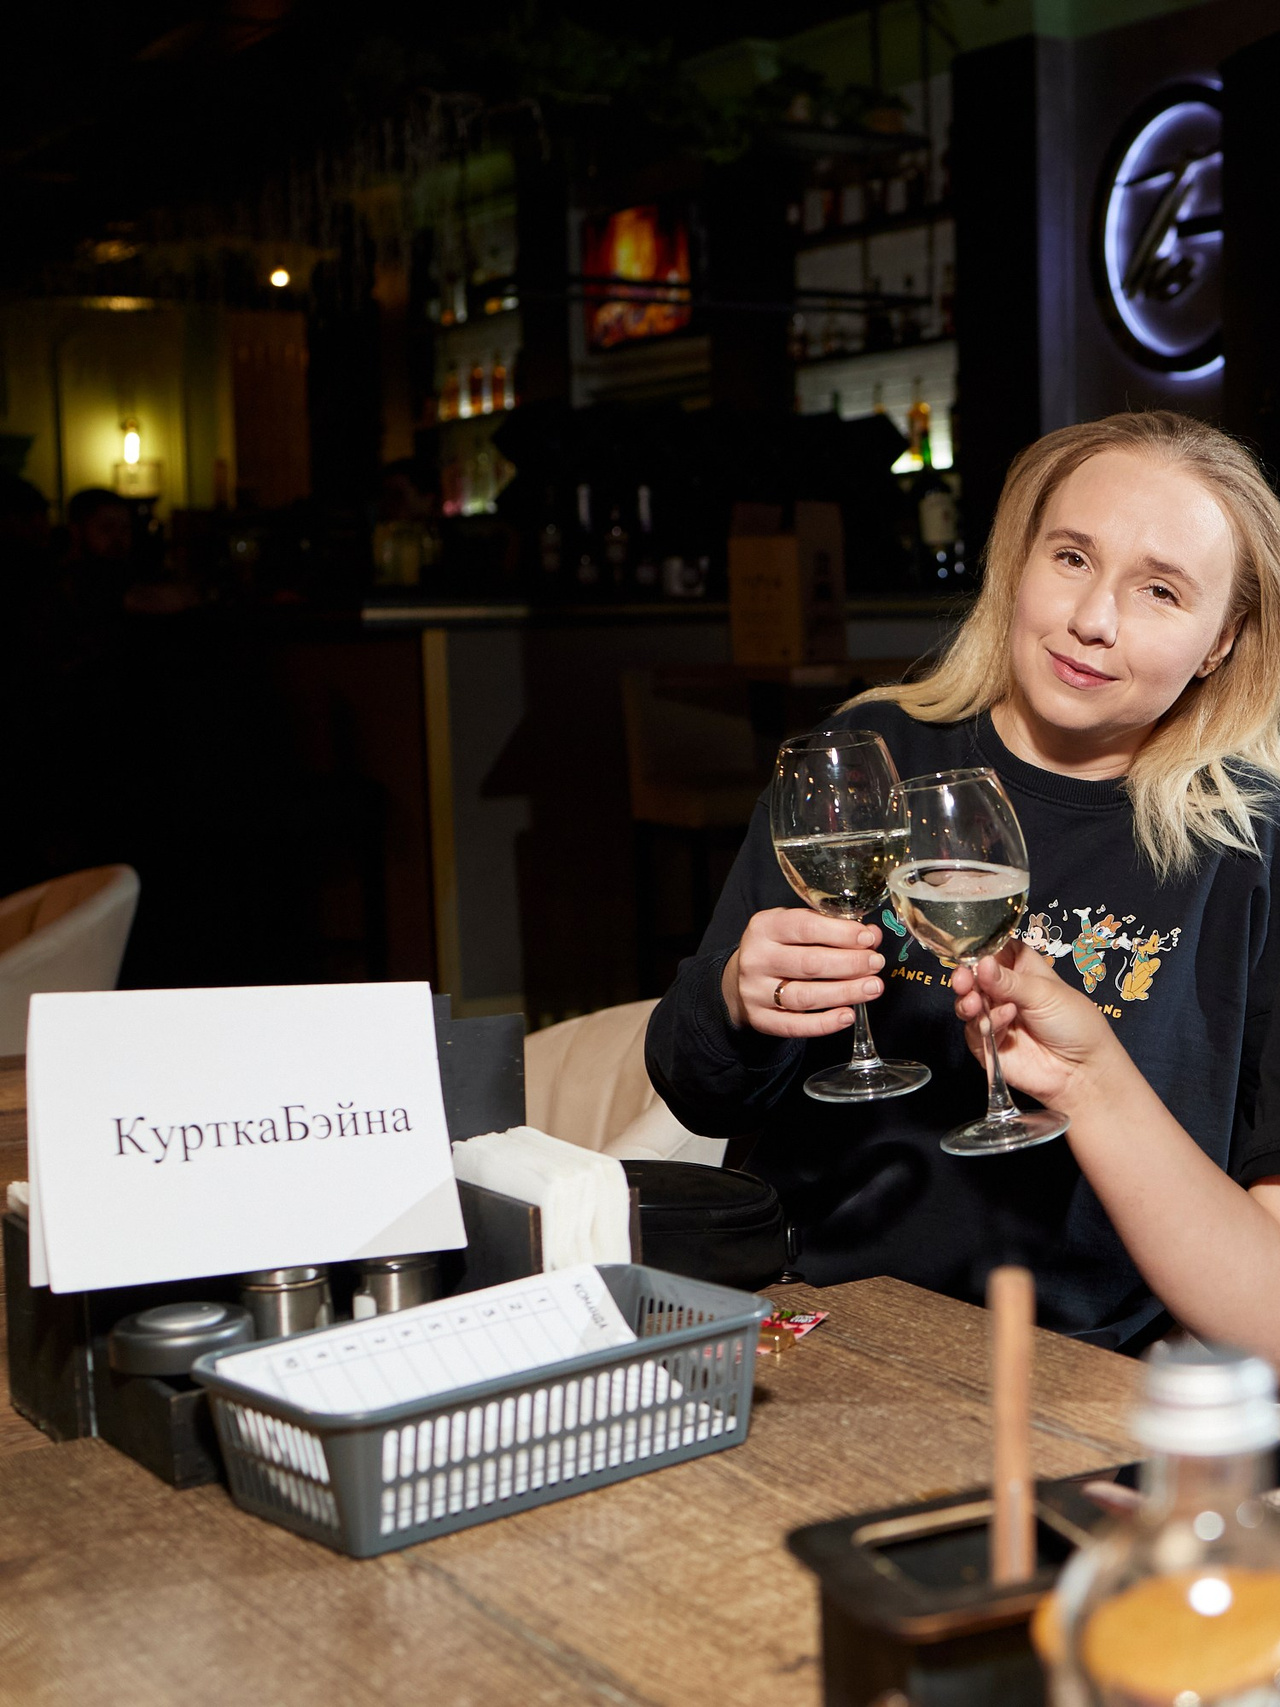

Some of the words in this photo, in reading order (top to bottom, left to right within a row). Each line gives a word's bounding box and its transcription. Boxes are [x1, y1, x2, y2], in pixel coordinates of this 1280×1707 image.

[891, 966, 933, 985] DANCE
[113, 1101, 413, 1164] КурткаБэйна
[573, 1283, 608, 1329] КОМАНДА
